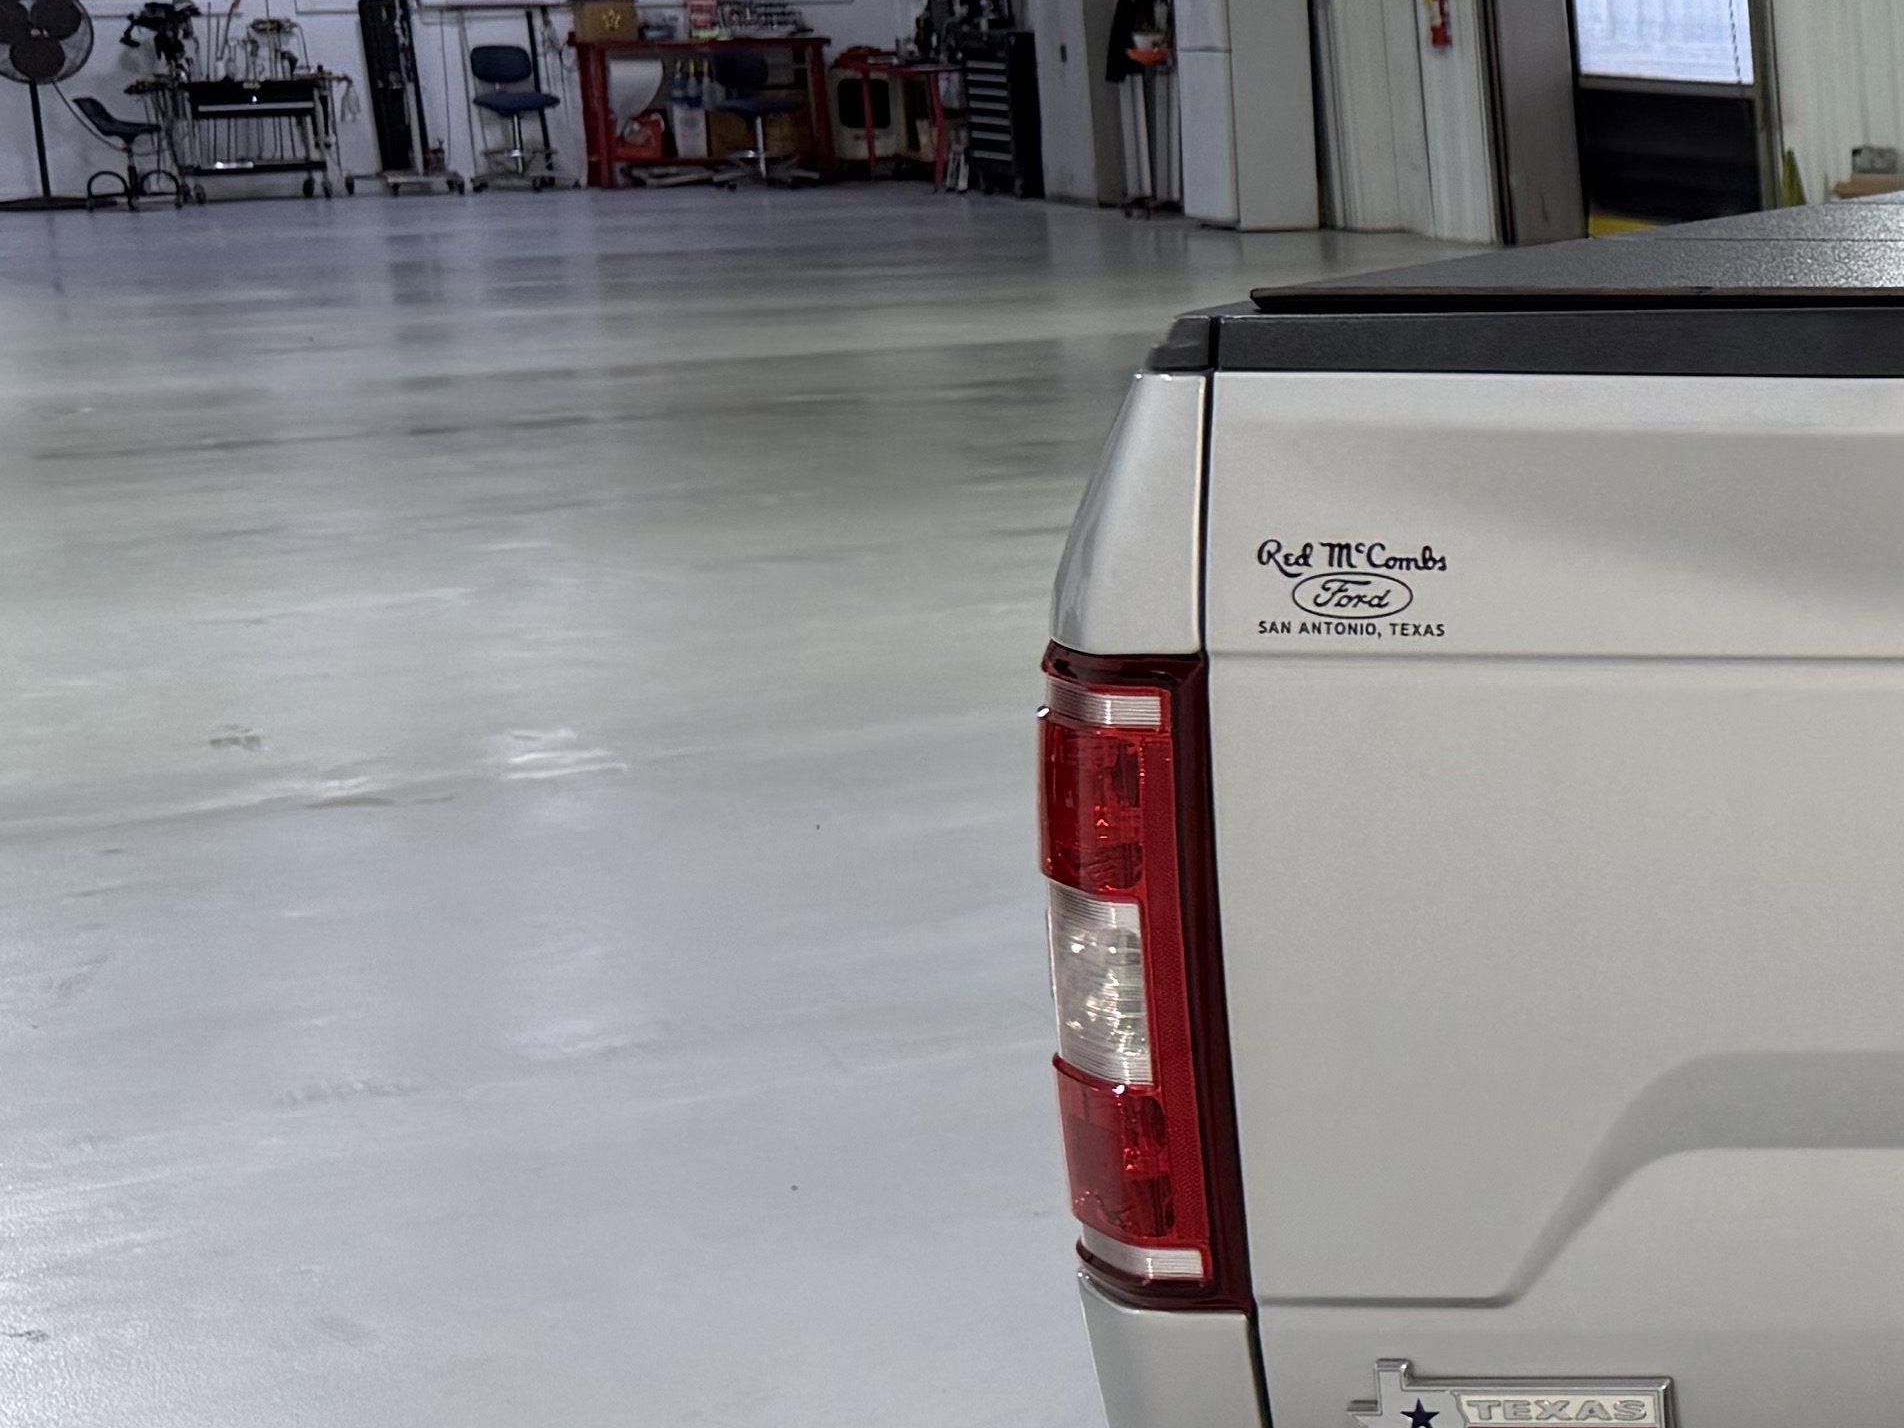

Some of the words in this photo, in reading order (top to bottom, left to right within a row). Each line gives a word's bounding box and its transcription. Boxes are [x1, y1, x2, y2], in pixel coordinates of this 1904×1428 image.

[1257, 538, 1313, 578] Red
[1319, 542, 1448, 572] McCombs
[1313, 578, 1392, 608] Ford
[1258, 620, 1292, 635] SAN
[1298, 622, 1383, 639] ANTONIO,
[1389, 623, 1446, 637] TEXAS
[1466, 1398, 1648, 1422] TEXAS
